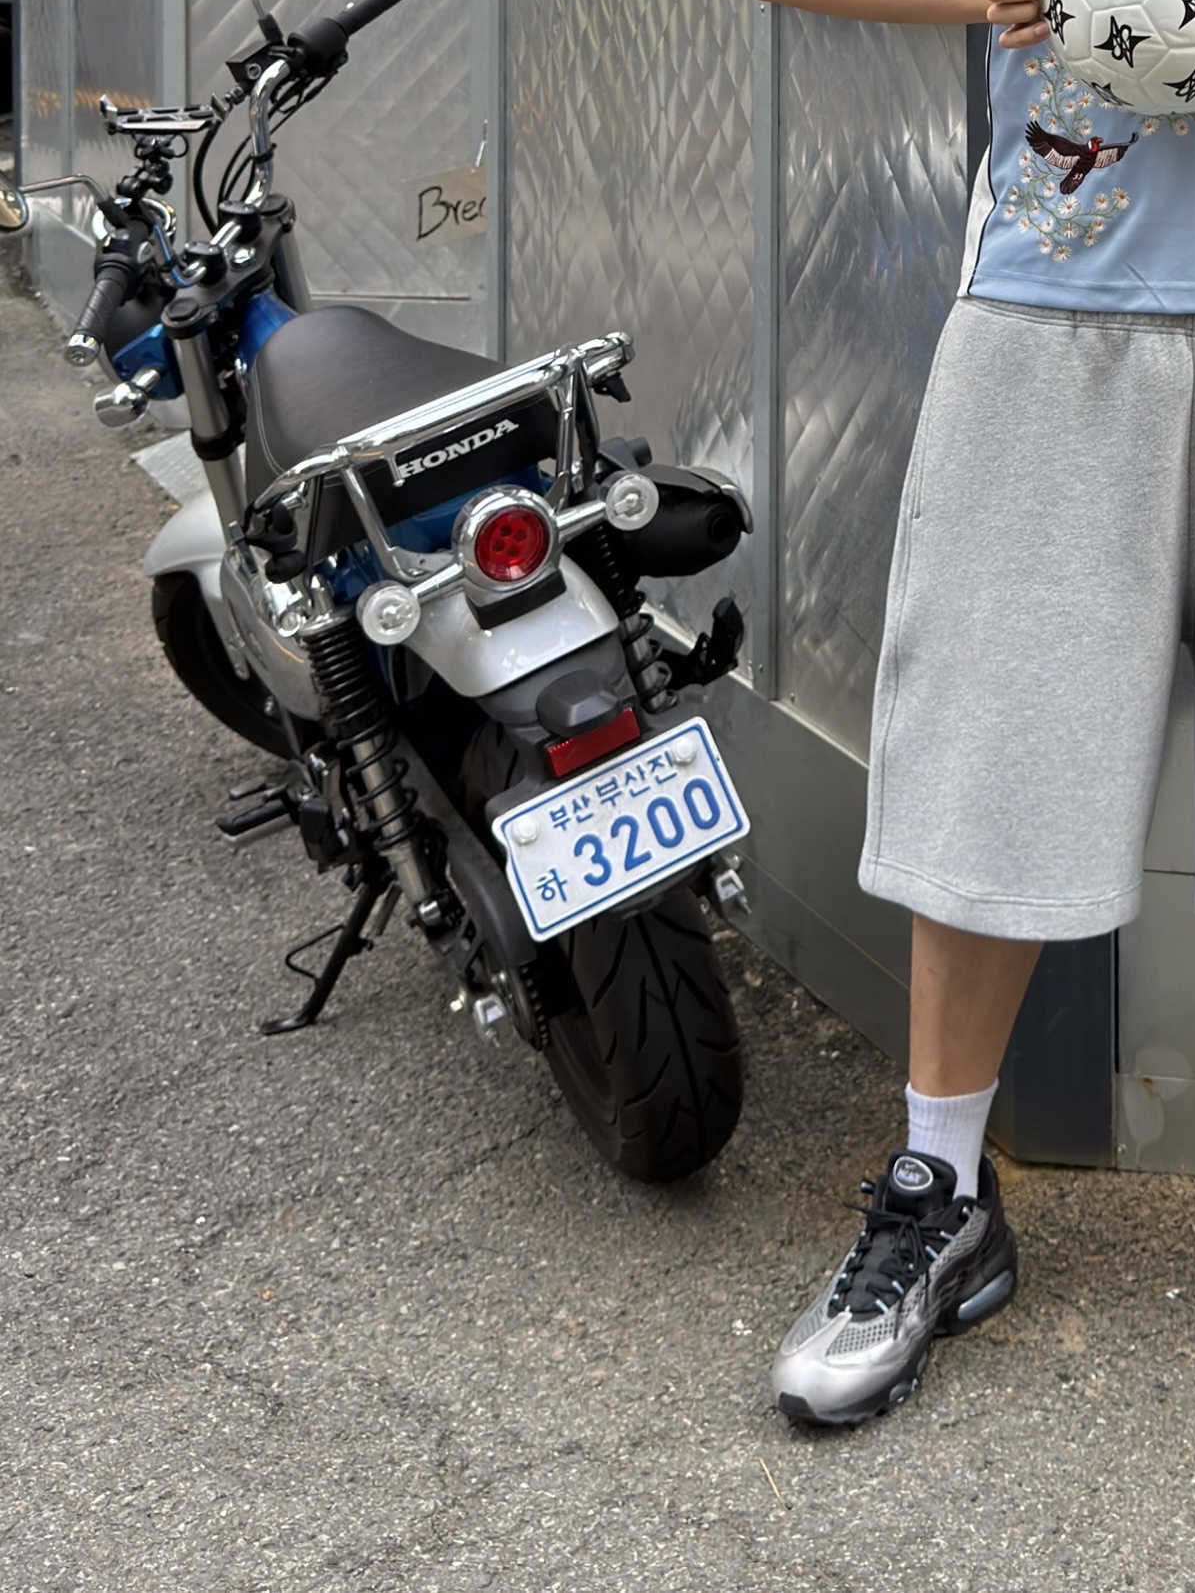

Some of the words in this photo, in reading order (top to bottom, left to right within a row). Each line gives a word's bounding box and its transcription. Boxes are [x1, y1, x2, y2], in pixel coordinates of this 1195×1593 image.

[399, 418, 519, 481] HONDA
[536, 868, 568, 902] 하
[573, 778, 721, 887] 3200
